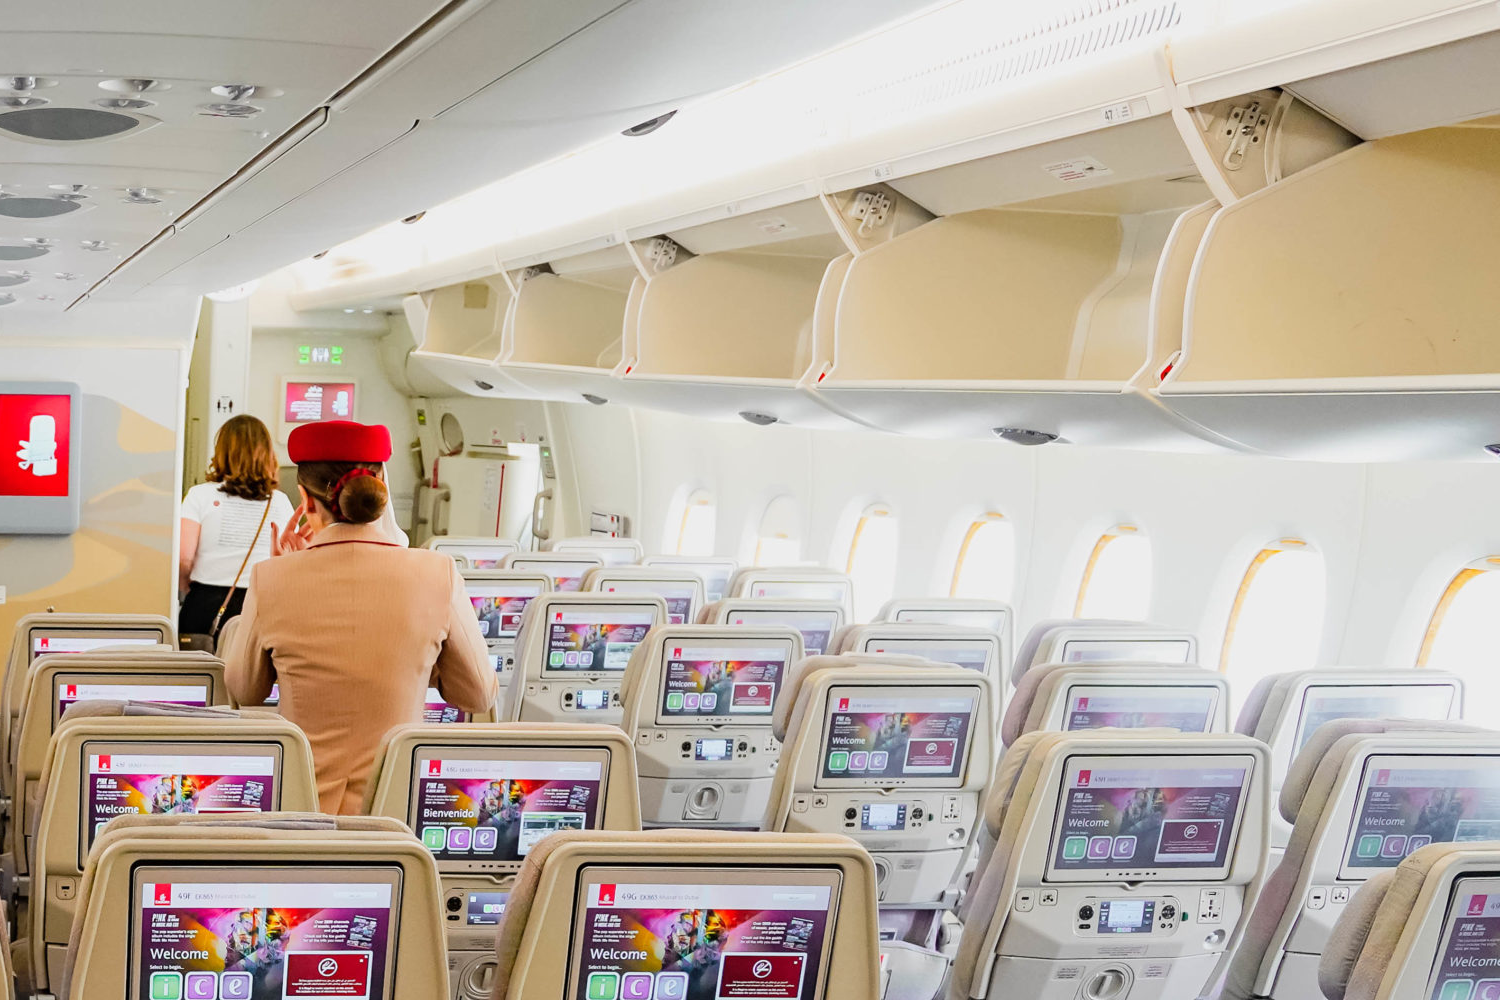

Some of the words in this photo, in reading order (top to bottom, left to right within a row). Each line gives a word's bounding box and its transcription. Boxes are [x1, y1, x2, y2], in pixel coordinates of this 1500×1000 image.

[95, 804, 139, 814] Welcome
[423, 808, 475, 819] Bienvenido
[1068, 818, 1110, 828] Welcome
[1364, 817, 1406, 826] Welcome
[150, 948, 209, 961] Welcome
[590, 949, 647, 961] Welcome
[163, 978, 169, 996] i
[194, 979, 208, 996] c
[229, 979, 242, 996] e
[600, 978, 606, 996] i
[631, 979, 644, 996] c
[665, 979, 678, 996] e
